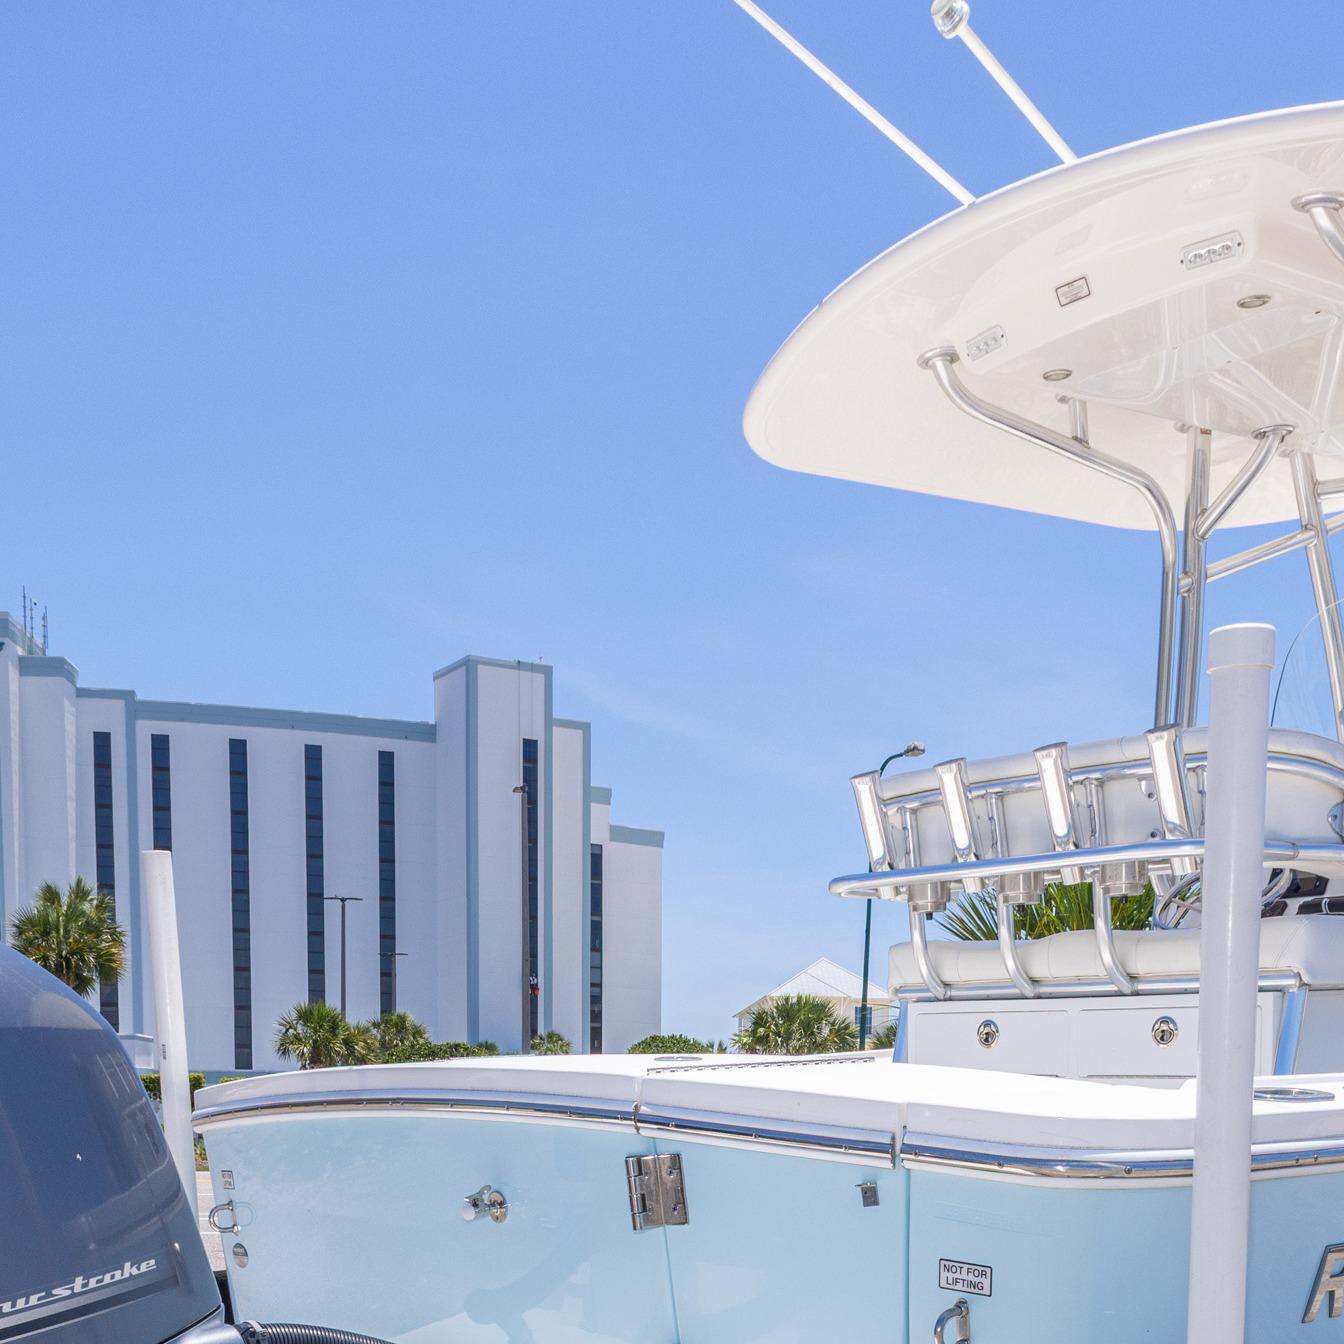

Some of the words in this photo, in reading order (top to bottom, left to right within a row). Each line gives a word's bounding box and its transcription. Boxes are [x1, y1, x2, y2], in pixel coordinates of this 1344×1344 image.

[943, 1264, 964, 1275] NOT
[966, 1267, 987, 1279] FOR
[946, 1276, 984, 1291] LIFTING
